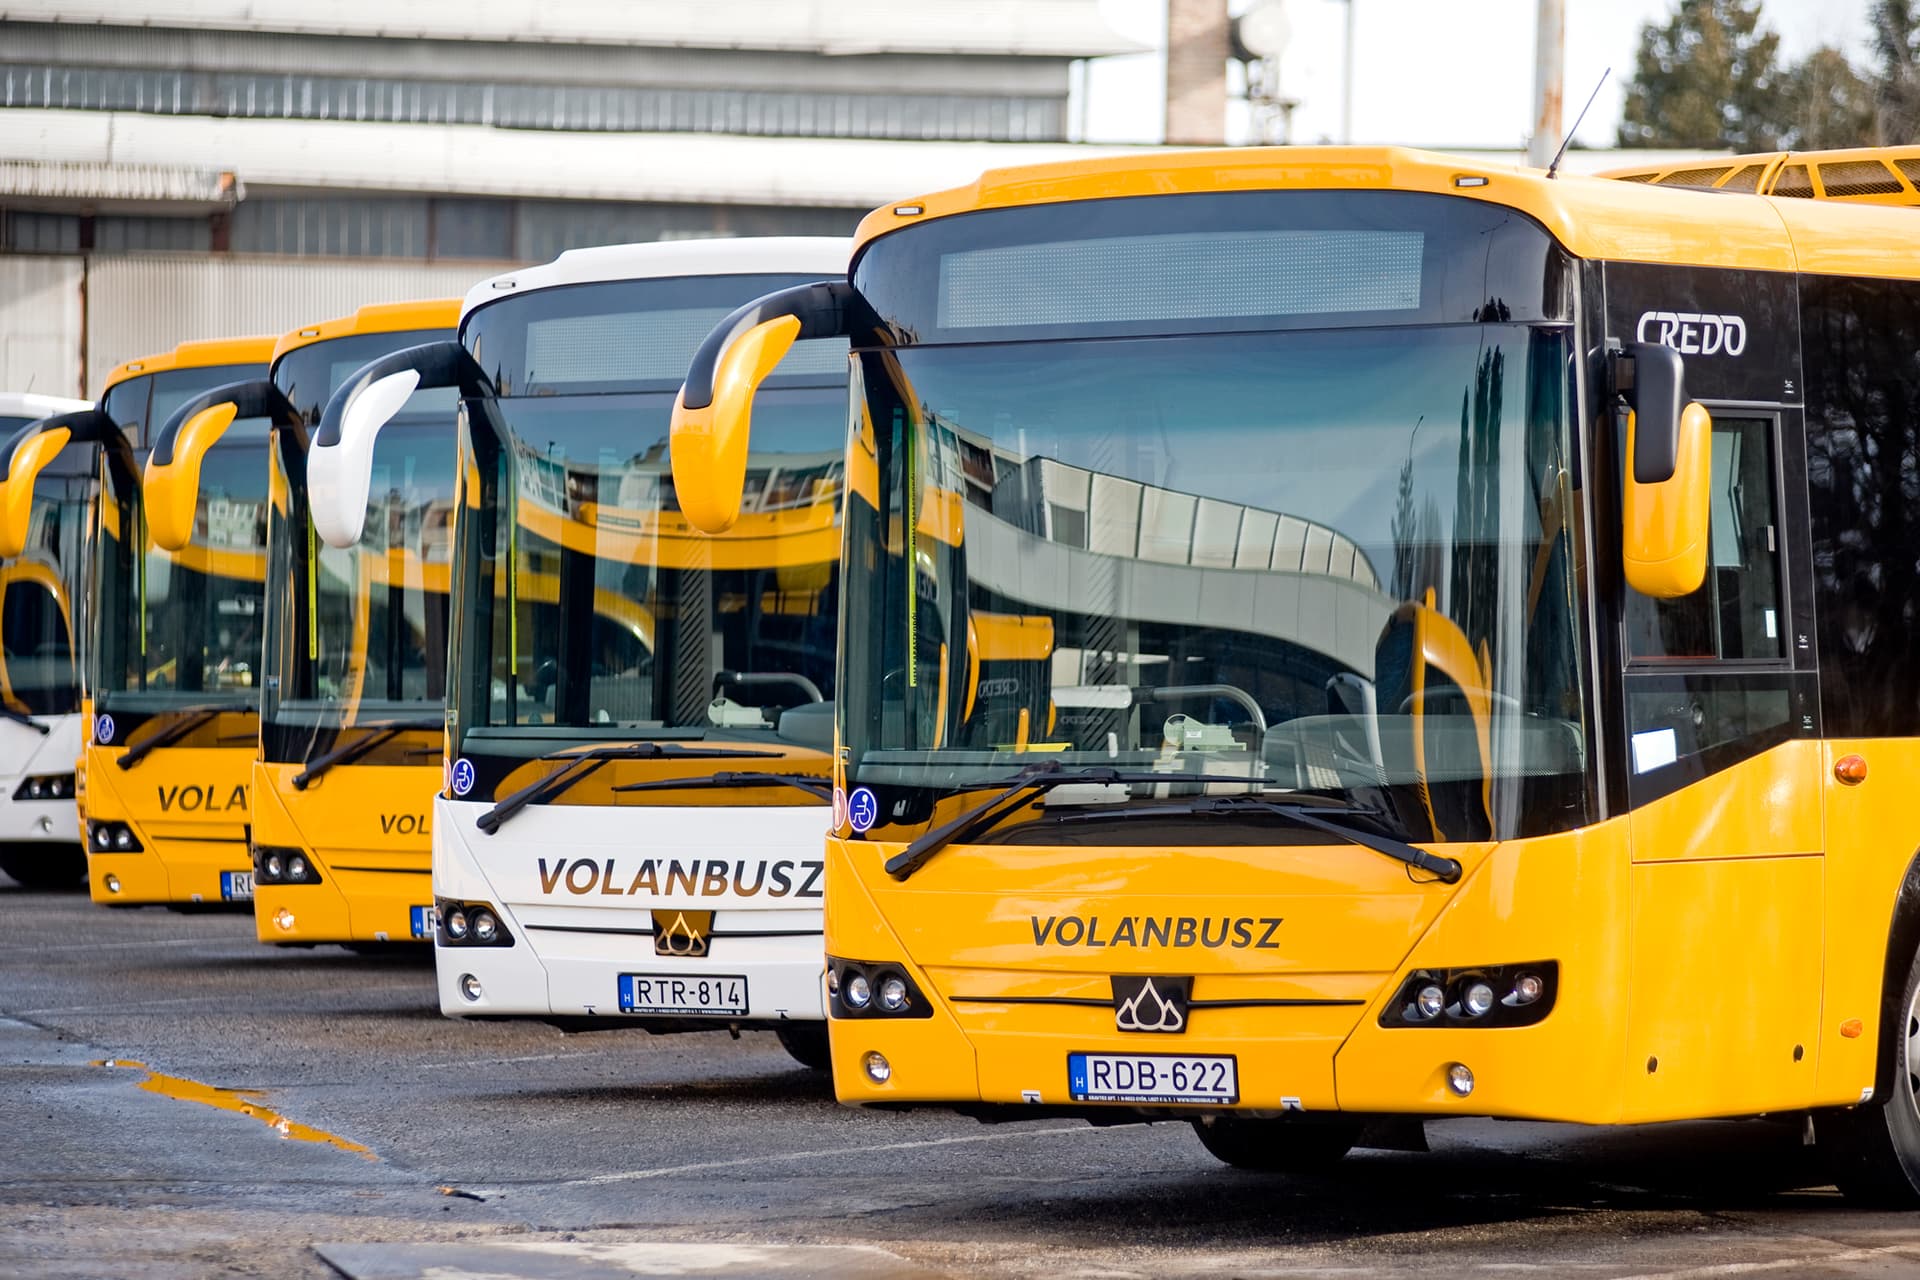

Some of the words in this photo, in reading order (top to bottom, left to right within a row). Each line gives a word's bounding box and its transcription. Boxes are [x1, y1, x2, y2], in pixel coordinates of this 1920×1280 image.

[1637, 311, 1746, 356] CREDO
[380, 814, 430, 834] VOL
[624, 993, 631, 1003] H
[637, 980, 740, 1006] RTR-814
[1075, 1076, 1084, 1088] H
[1093, 1060, 1227, 1092] RDB-622
